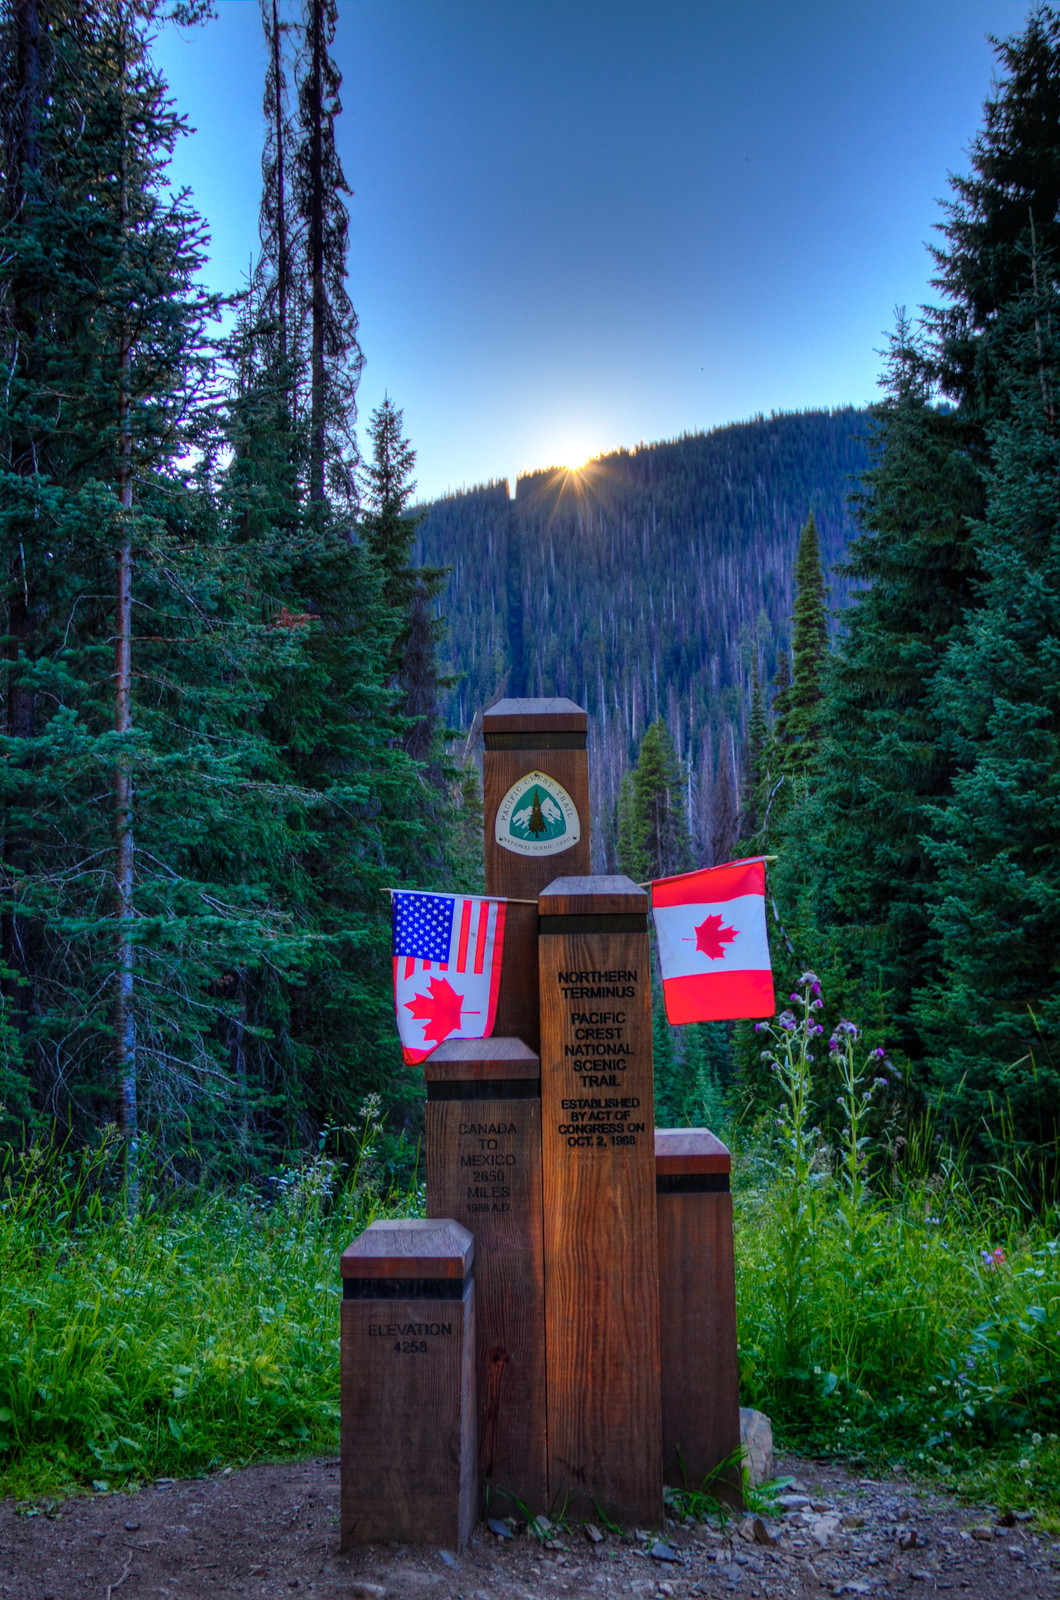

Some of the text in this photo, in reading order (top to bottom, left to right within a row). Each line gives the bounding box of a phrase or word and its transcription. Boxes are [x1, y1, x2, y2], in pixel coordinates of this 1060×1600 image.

[500, 774, 574, 822] PACIFIC CREST TRAIL
[503, 837, 530, 850] NATIONAL
[556, 836, 573, 847] TRAIL
[558, 970, 638, 984] NORTHERN
[561, 986, 635, 999] TERMINUS
[571, 1012, 626, 1025] PACIFIC
[575, 1027, 623, 1040] CREST
[564, 1043, 634, 1056] NATIONAL
[573, 1059, 626, 1072] SCENIC
[580, 1075, 620, 1088] TRAIL
[561, 1098, 640, 1109] ESTABLISHED
[570, 1110, 631, 1122] BY ACT OF
[458, 1122, 518, 1135] CANADA
[558, 1122, 645, 1135] CONGRESS ON
[477, 1139, 498, 1150] TO
[567, 1135, 636, 1148] OCT. 2, 1968
[461, 1154, 516, 1167] MEXICO
[473, 1170, 504, 1183] 2650
[467, 1186, 511, 1199] MILES
[466, 1203, 490, 1213] 1988
[368, 1323, 452, 1337] ELEVATION
[393, 1341, 428, 1354] 4258
